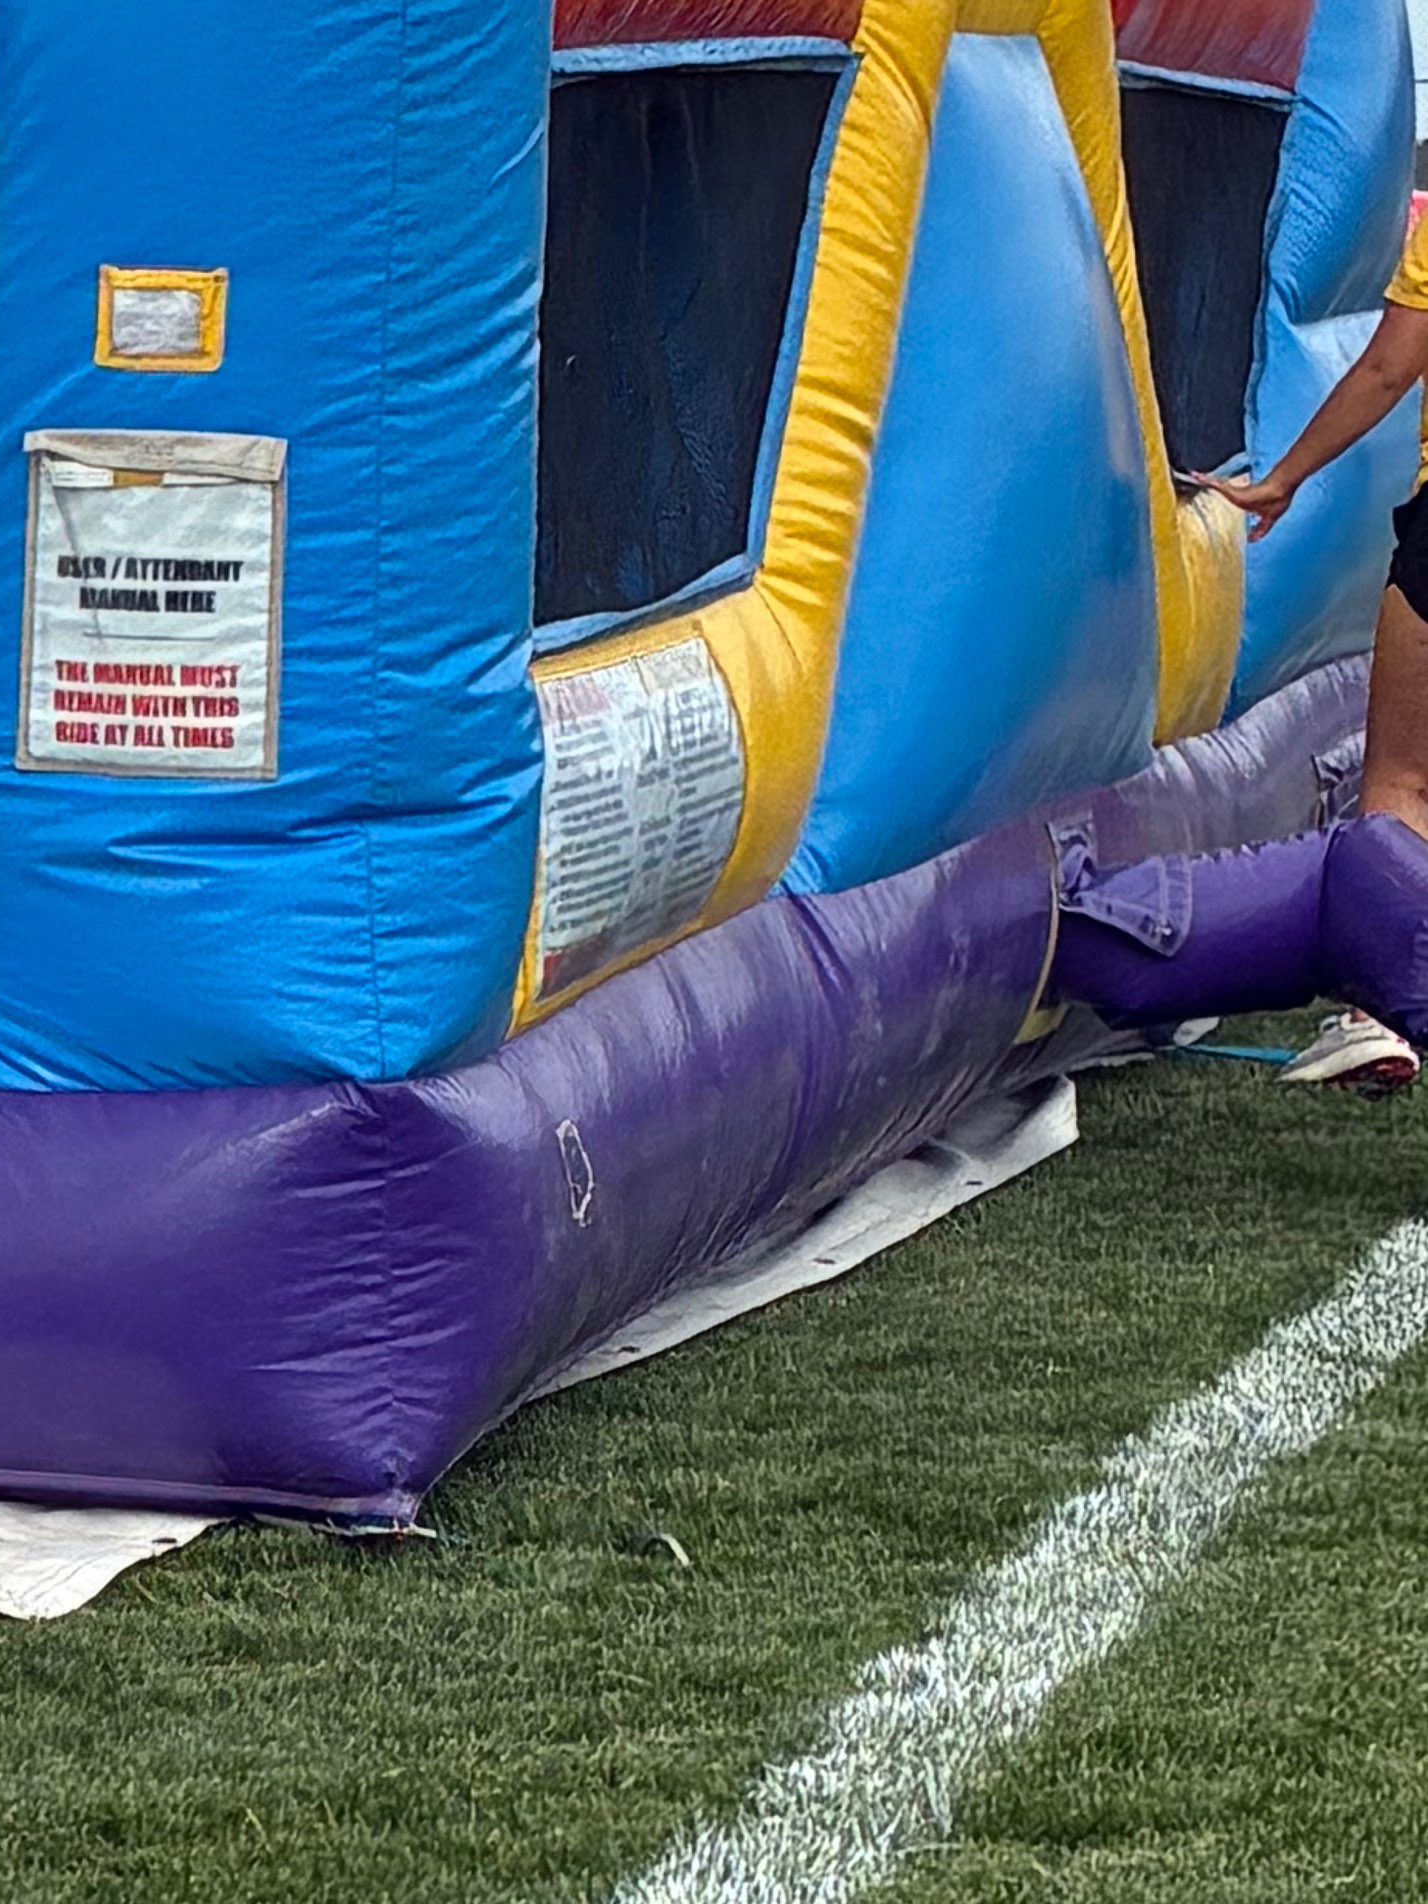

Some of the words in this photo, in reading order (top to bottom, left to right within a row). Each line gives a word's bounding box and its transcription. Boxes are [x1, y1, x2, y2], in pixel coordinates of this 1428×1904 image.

[57, 555, 106, 579] USER
[124, 557, 245, 582] ATTENDANT
[79, 587, 160, 612] MANUAL
[164, 590, 216, 613] HERE
[55, 659, 89, 683] THE
[93, 662, 175, 686] MANUAL
[180, 664, 241, 688] MUST
[54, 689, 126, 715] REMAIN
[131, 694, 187, 717] WITH
[192, 696, 240, 717] THIS
[55, 721, 100, 745] RIDE
[104, 723, 129, 746] AT
[133, 725, 165, 747] ALL
[170, 726, 235, 749] TIMES
